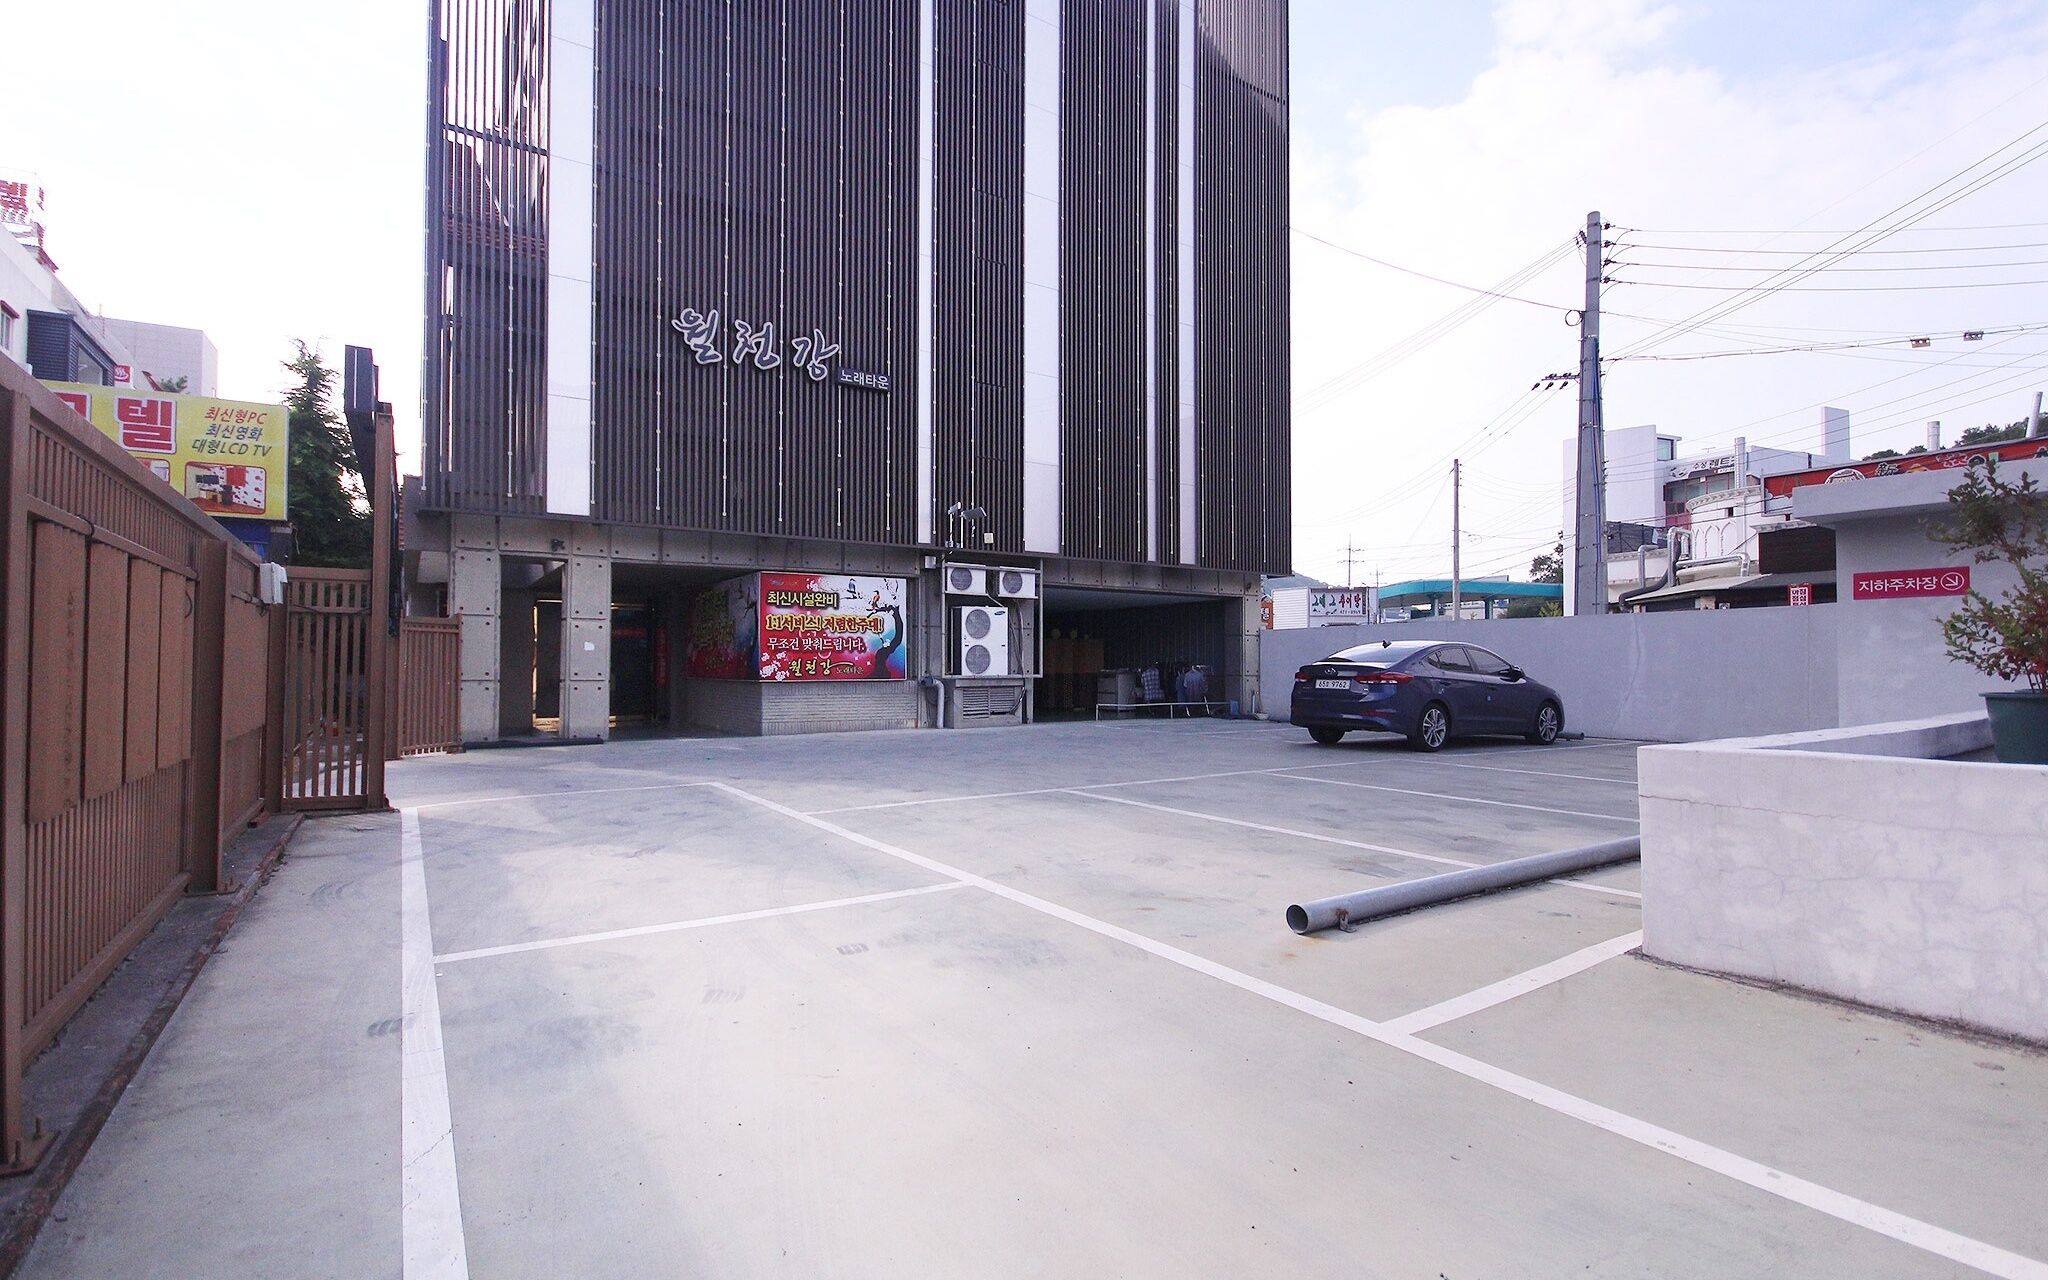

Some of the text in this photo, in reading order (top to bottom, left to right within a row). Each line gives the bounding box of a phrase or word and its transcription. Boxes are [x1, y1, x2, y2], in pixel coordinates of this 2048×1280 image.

[840, 369, 889, 390] 노래타운
[204, 406, 268, 425] 최신형PC
[205, 423, 263, 441] 최신영화
[192, 439, 272, 457] 대형LCD TV
[1858, 576, 1938, 592] 지하주차장
[767, 590, 838, 607] 최신시설완비
[1338, 593, 1361, 608] 추어탕
[766, 614, 884, 633] 1:1서비스! 저렴한주대!
[767, 637, 866, 651] 무조건 맞춰드립니다.
